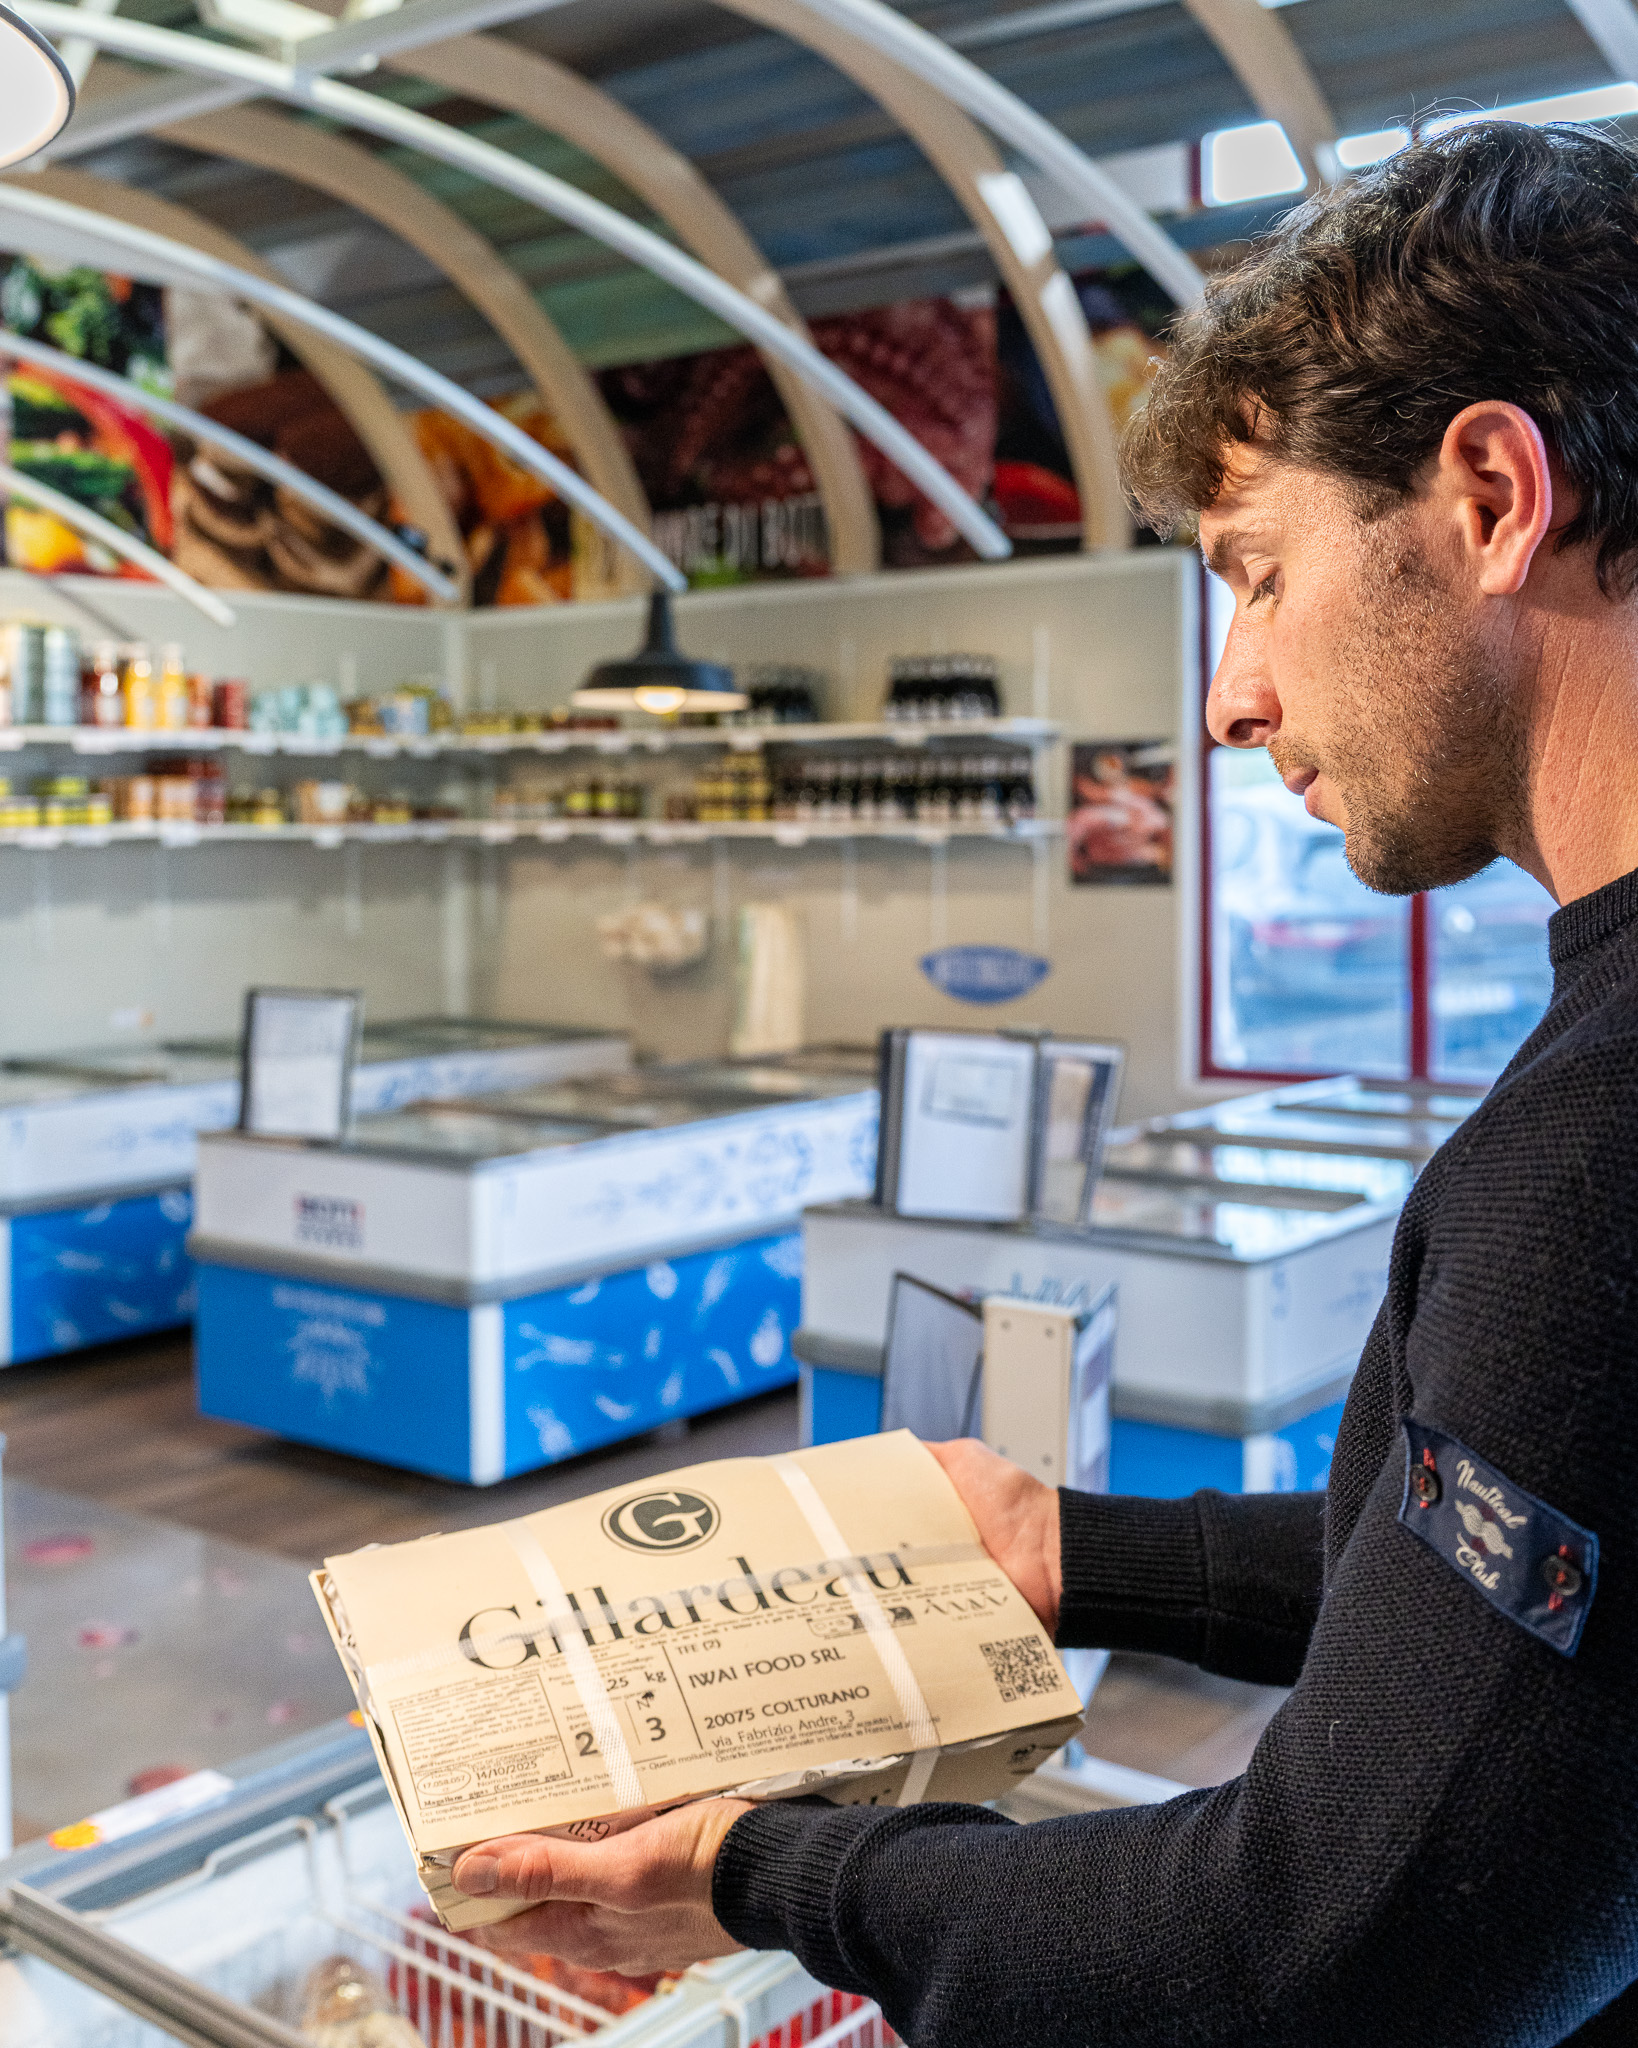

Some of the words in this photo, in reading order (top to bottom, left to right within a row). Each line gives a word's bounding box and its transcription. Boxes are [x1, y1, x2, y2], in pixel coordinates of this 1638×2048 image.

[1456, 1459, 1528, 1529] Nautical
[610, 1492, 713, 1546] G
[1455, 1532, 1501, 1590] Club
[458, 1552, 921, 1670] Gillardeau
[644, 1671, 667, 1683] kg
[688, 1666, 738, 1689] IWAI
[745, 1653, 806, 1678] FOOD
[810, 1647, 846, 1665] SRL
[704, 1708, 755, 1730] 20075
[761, 1685, 870, 1717] COLTURANO
[711, 1735, 733, 1749] via
[737, 1722, 793, 1743] Fabrizio
[799, 1714, 843, 1731] Andre,
[845, 1709, 855, 1723] 3
[646, 1717, 666, 1742] 3
[476, 1761, 538, 1781] 14/10/2025
